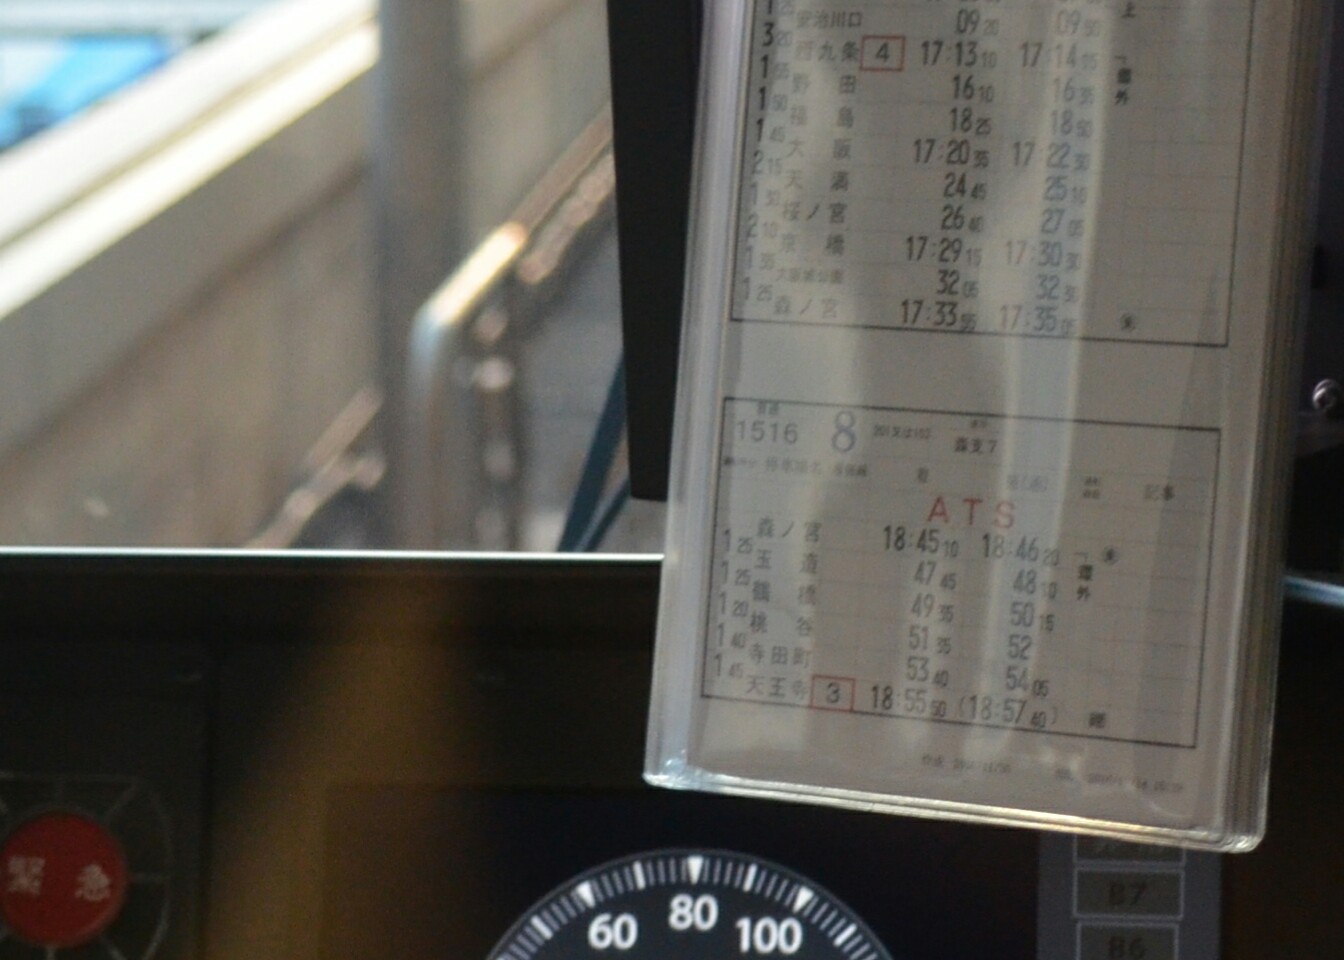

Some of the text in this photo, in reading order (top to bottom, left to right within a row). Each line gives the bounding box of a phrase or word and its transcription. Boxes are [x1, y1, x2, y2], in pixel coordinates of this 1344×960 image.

[763, 21, 775, 47] 3
[954, 8, 980, 36] 09
[1054, 9, 1081, 36] 09
[760, 54, 768, 78] 1
[796, 40, 859, 62] 西九条
[875, 42, 890, 63] 4
[920, 40, 978, 68] 17:13
[758, 86, 766, 110] 1
[951, 74, 974, 101] 16
[1054, 78, 1075, 102] 16
[756, 118, 764, 142] 1
[949, 106, 972, 133] 18
[1052, 110, 1072, 135] 18
[786, 136, 852, 160] 大阪
[913, 138, 970, 165] 17:20
[943, 171, 966, 200] 24
[1043, 175, 1067, 202] 25
[940, 203, 965, 231] 26
[1041, 207, 1065, 234] 27
[905, 235, 963, 263] 17:29
[1005, 240, 1062, 267] 17:30
[756, 284, 773, 302] 25
[936, 269, 960, 296] 32
[1036, 274, 1059, 301] 32
[900, 298, 960, 327] 17:33
[1000, 304, 1058, 333] 17:35
[738, 420, 798, 445] 1516
[831, 410, 856, 453] 8
[927, 496, 1014, 528] ATS
[723, 528, 753, 555] 1 25
[757, 516, 822, 543] 森ノ宮
[882, 523, 940, 554] 18:45
[942, 540, 959, 560] 10
[981, 532, 1039, 562] 18:46
[721, 559, 751, 586] 1 25
[913, 560, 937, 586] 47
[1013, 569, 1037, 595] 48
[719, 591, 749, 617] 1 20
[911, 592, 935, 618] 49
[1010, 600, 1035, 628] 50
[717, 622, 725, 647] 1
[750, 611, 813, 637] 桃谷
[908, 624, 929, 651] 51
[1008, 633, 1033, 661] 52
[714, 653, 723, 677] 1
[749, 642, 812, 669] 寺田町
[905, 655, 929, 682] 53
[1005, 665, 1028, 691] 54
[746, 675, 809, 701] 天王寺
[825, 682, 841, 704] 3
[872, 683, 927, 714] 18:55
[669, 893, 719, 931] 80
[587, 912, 639, 951] 60
[736, 916, 803, 955] 100
